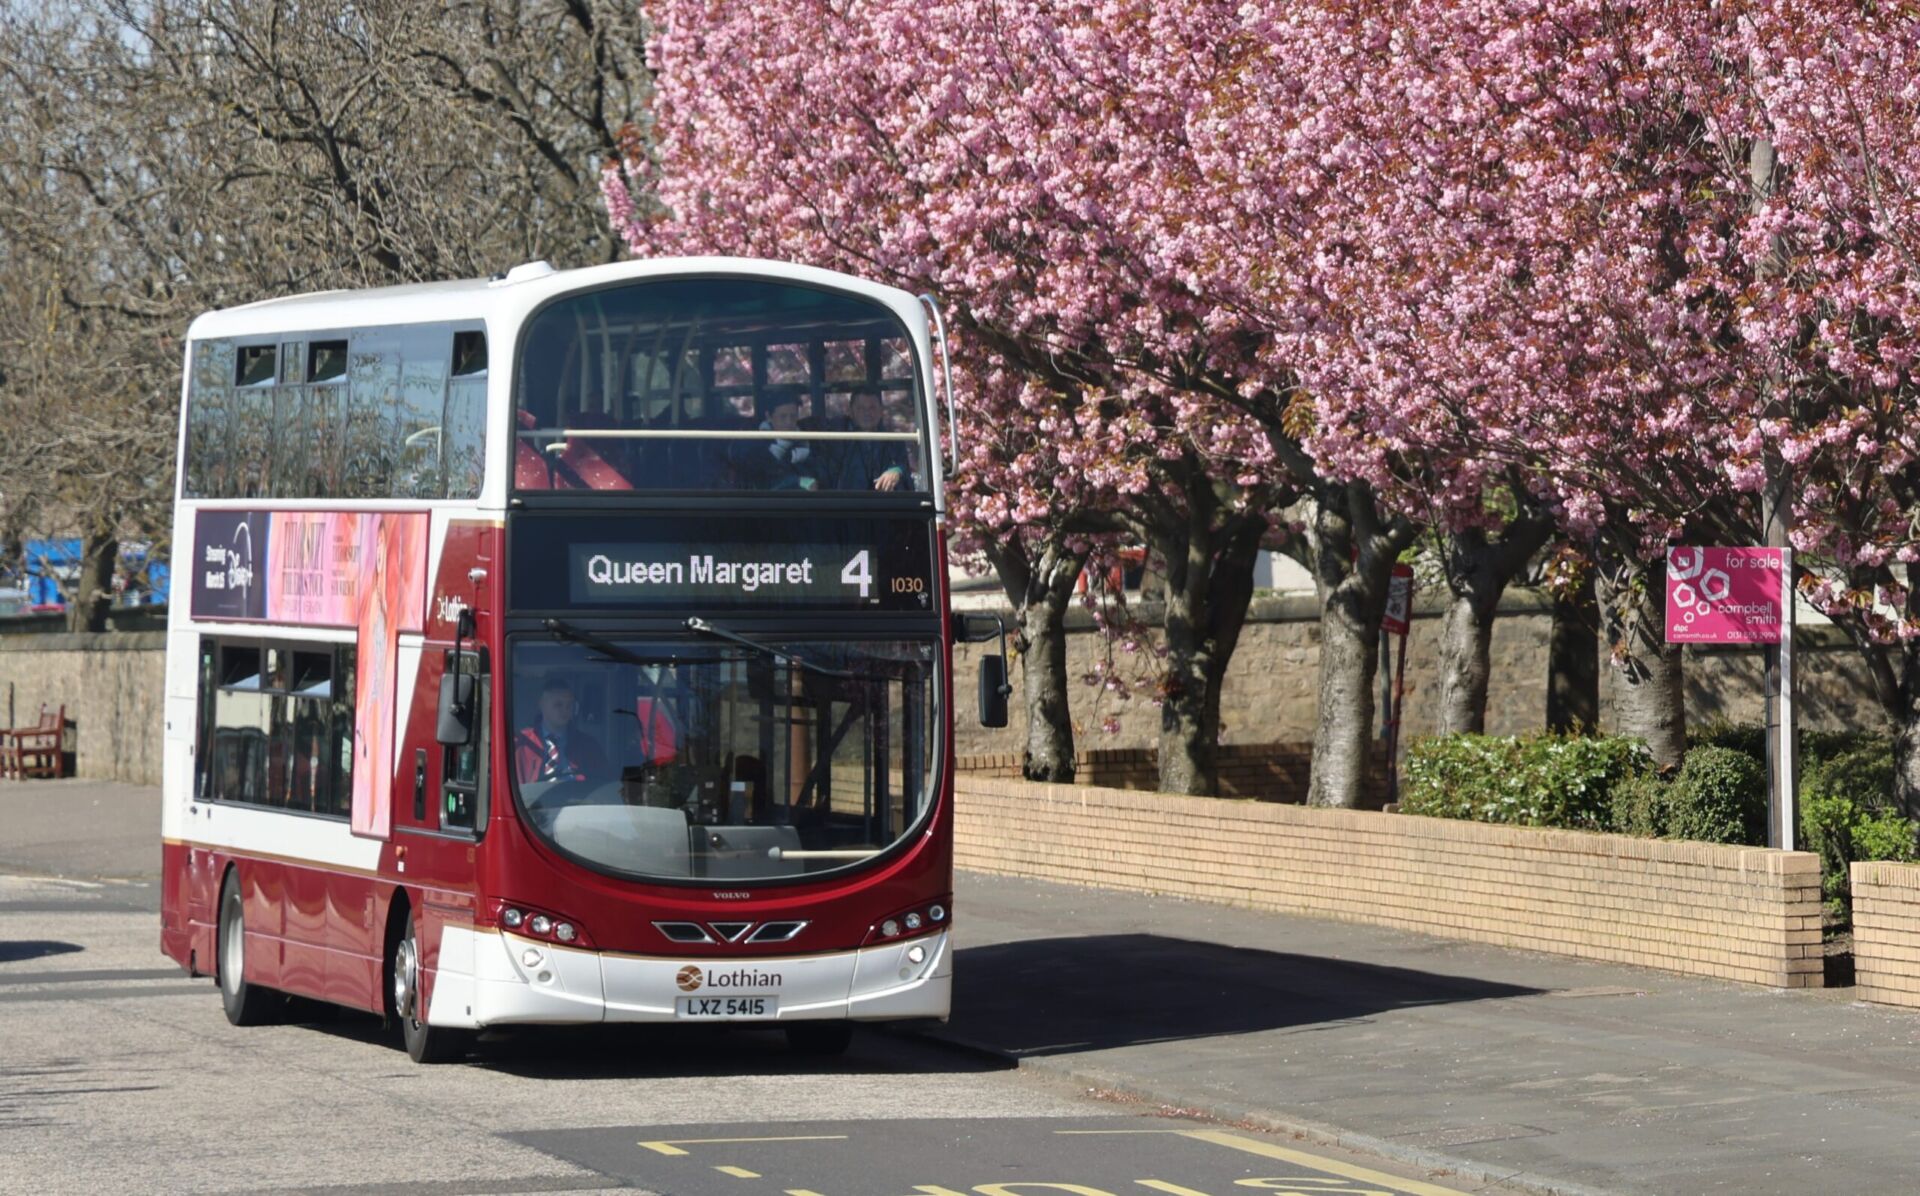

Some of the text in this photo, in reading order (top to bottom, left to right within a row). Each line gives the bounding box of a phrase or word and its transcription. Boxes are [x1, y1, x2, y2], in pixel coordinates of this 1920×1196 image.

[1725, 553, 1780, 569] for sale
[588, 554, 813, 591] Queen Margaret
[841, 550, 873, 597] 4
[891, 577, 924, 593] 1030
[1717, 602, 1773, 616] campbell
[1745, 614, 1777, 625] smith
[707, 969, 782, 987] Lothian
[687, 999, 764, 1015] LXZ 5415
